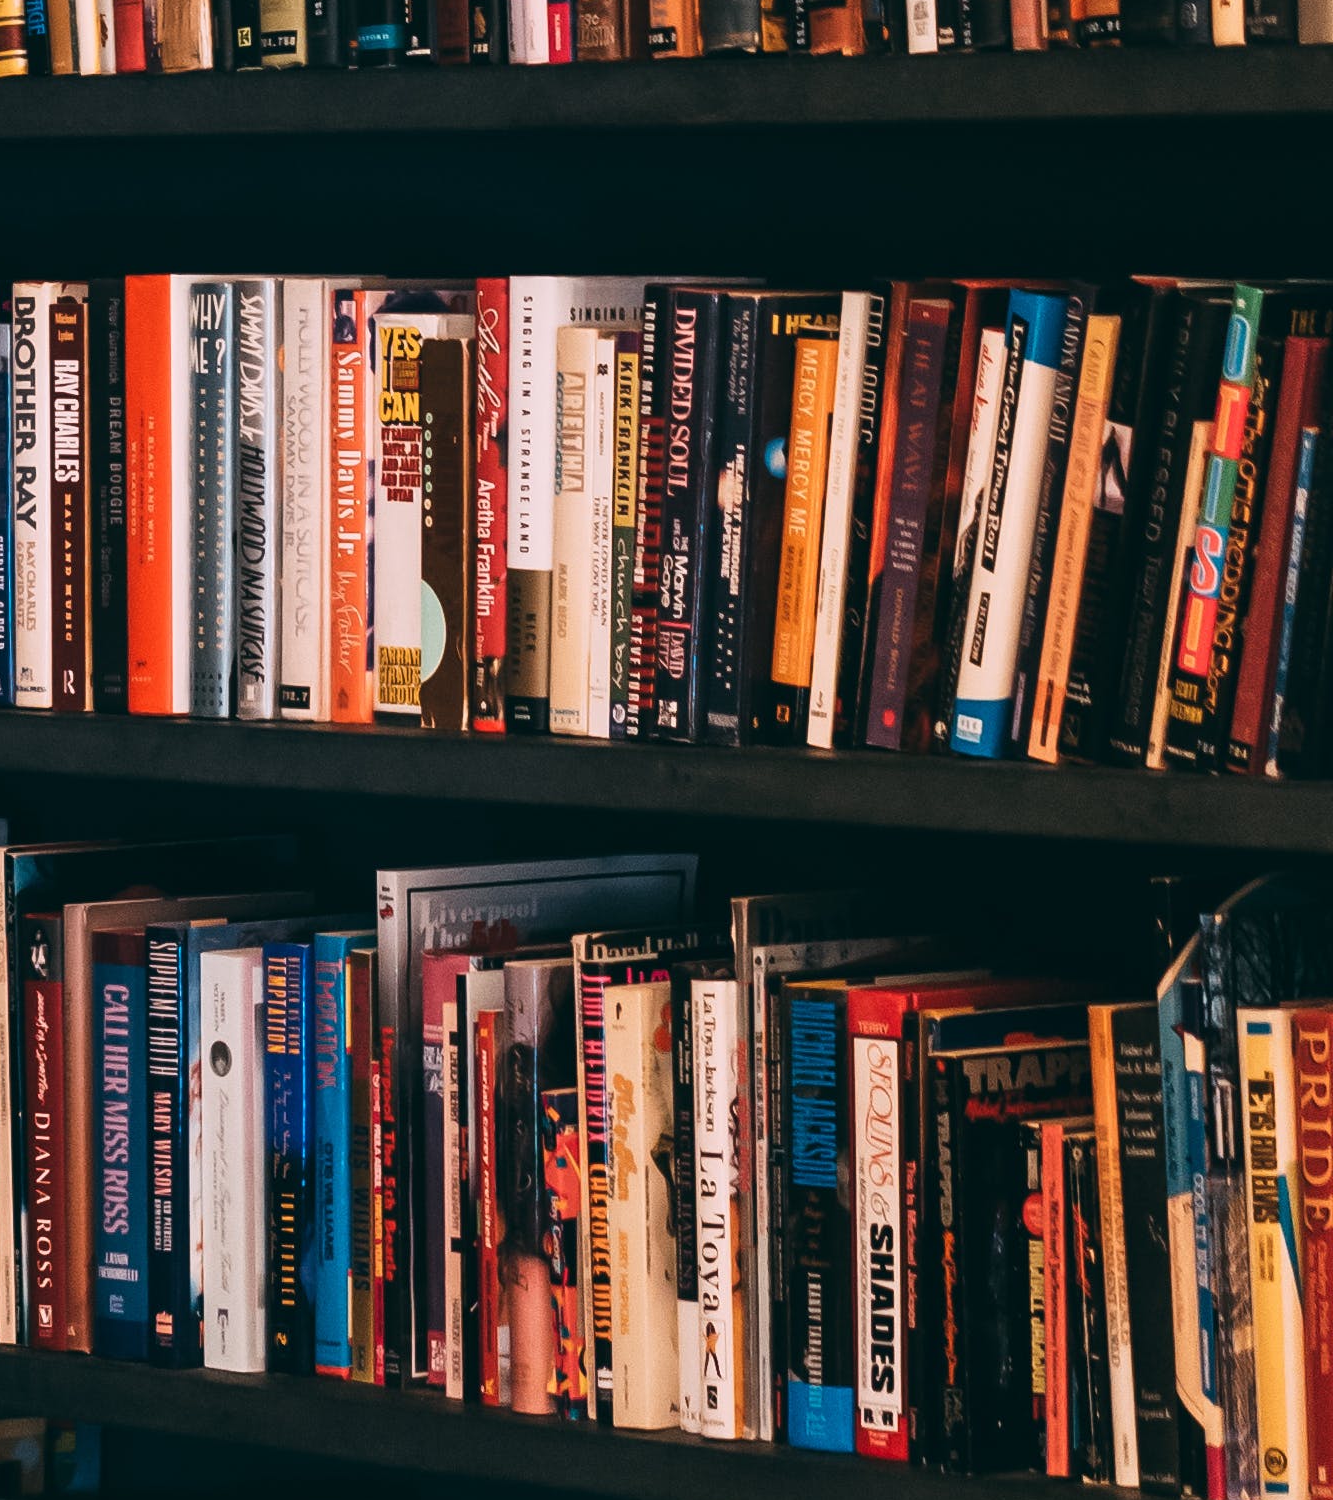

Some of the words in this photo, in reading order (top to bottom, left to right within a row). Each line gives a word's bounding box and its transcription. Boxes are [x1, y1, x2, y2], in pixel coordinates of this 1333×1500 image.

[522, 296, 532, 369] SINGING
[14, 297, 36, 458] BROTHER
[55, 359, 79, 396] RAY
[520, 381, 531, 396] IN
[520, 409, 531, 417] A
[55, 399, 79, 482] CHARLES
[519, 429, 531, 504] STRANGE
[16, 465, 37, 530] RAY
[477, 479, 496, 539] Aretha
[519, 513, 530, 554] LAND
[477, 544, 496, 616] Franklin
[33, 1112, 50, 1204] DIANA
[1298, 1028, 1332, 1233] PRIDE
[699, 1150, 723, 1204] La
[36, 1219, 52, 1288] ROSS
[696, 1215, 725, 1315] Toya
[870, 1223, 895, 1393] SHADES
